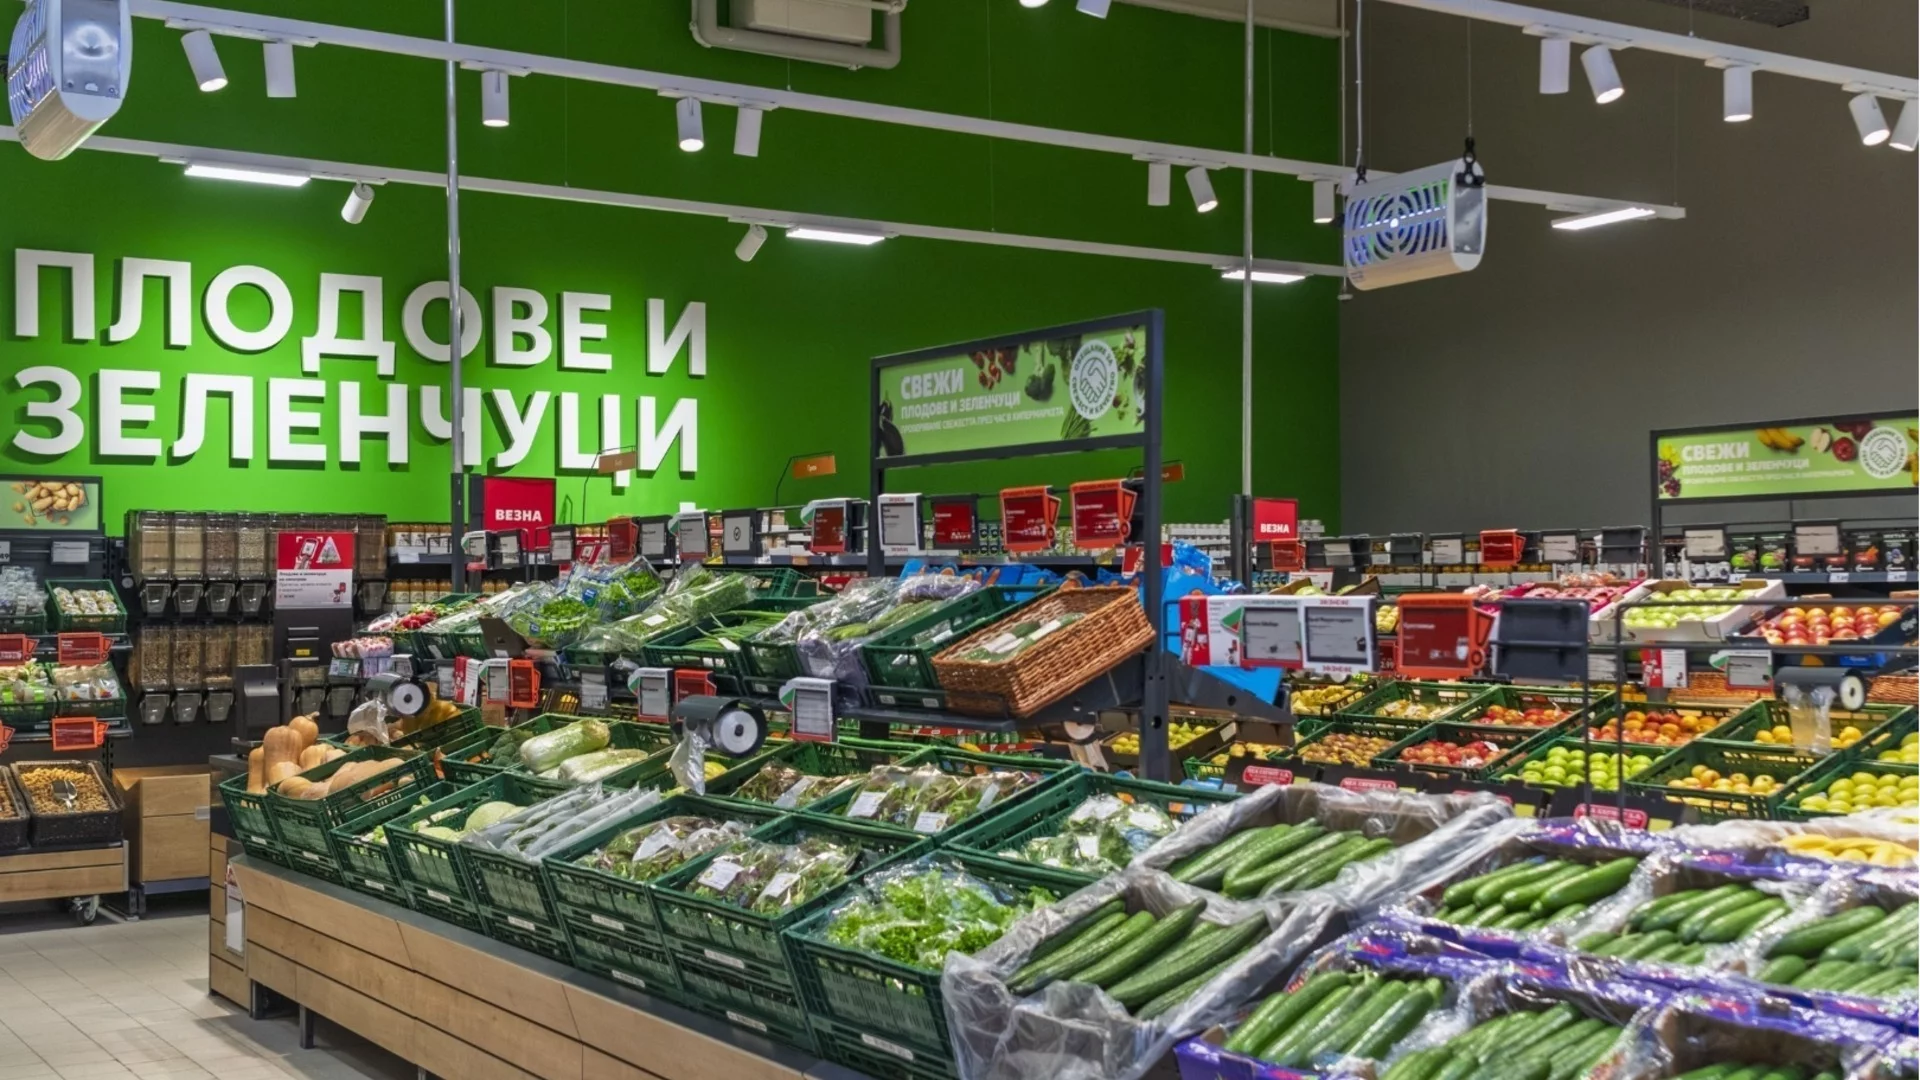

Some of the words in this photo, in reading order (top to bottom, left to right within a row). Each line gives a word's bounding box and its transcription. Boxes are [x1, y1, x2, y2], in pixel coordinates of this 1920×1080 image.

[13, 247, 612, 377] ПЛОДОВЕ
[646, 298, 707, 377] И
[900, 368, 964, 400] СВЕЖИ
[901, 400, 949, 420] ПЛОДОВЕ
[950, 399, 958, 412] И
[959, 391, 1021, 411] ЗЕЛЕНЧУЦИ
[12, 365, 699, 488] ЗЕЛЕНЧУЦИ
[1682, 442, 1750, 462] СВЕЖИ
[1682, 462, 1734, 475] ПЛОДОВЕ
[1735, 461, 1743, 472] И
[1745, 458, 1810, 472] ЗЕЛЕНЧУЦИ
[494, 509, 543, 522] ВЕЗНА
[1260, 523, 1290, 533] ВЕЗНА
